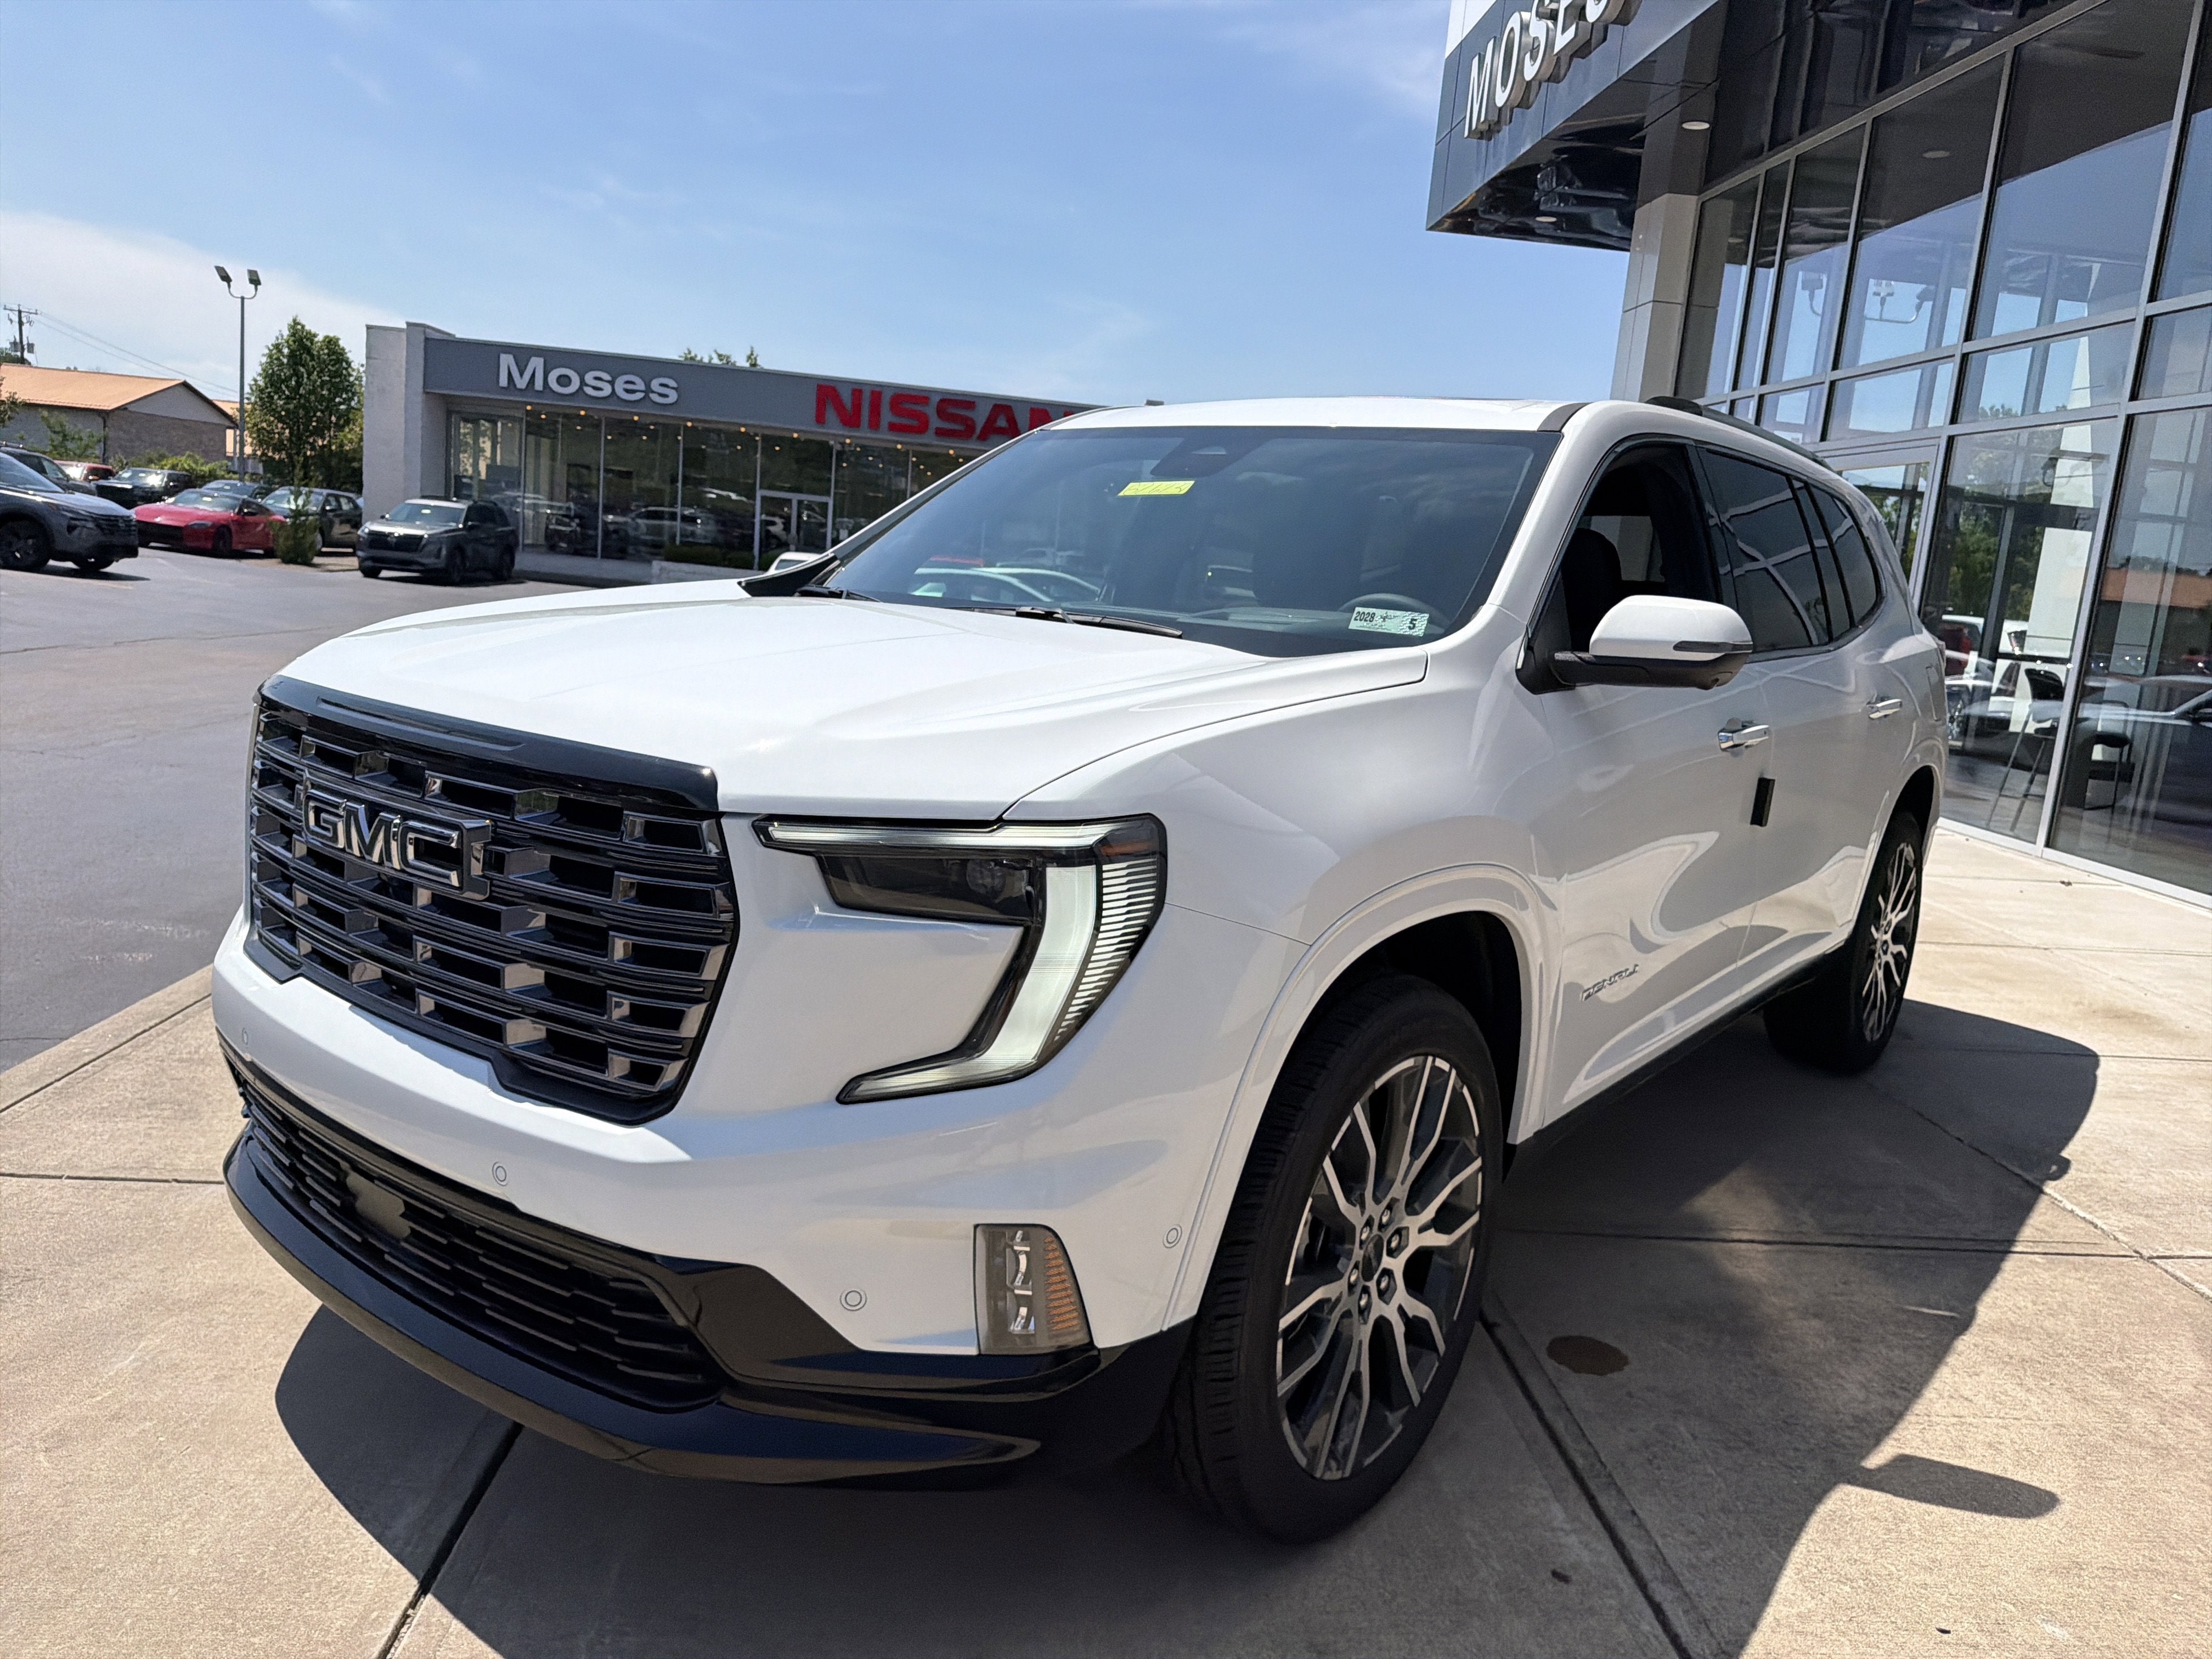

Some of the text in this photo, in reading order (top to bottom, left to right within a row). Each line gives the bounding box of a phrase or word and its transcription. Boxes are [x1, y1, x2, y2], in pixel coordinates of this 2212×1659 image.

[1464, 0, 1610, 138] MOS
[499, 353, 679, 404] Moses
[1353, 611, 1376, 623] 2028
[1408, 618, 1418, 630] 5
[303, 789, 461, 887] GMC
[1580, 963, 1639, 1002] DENALI
